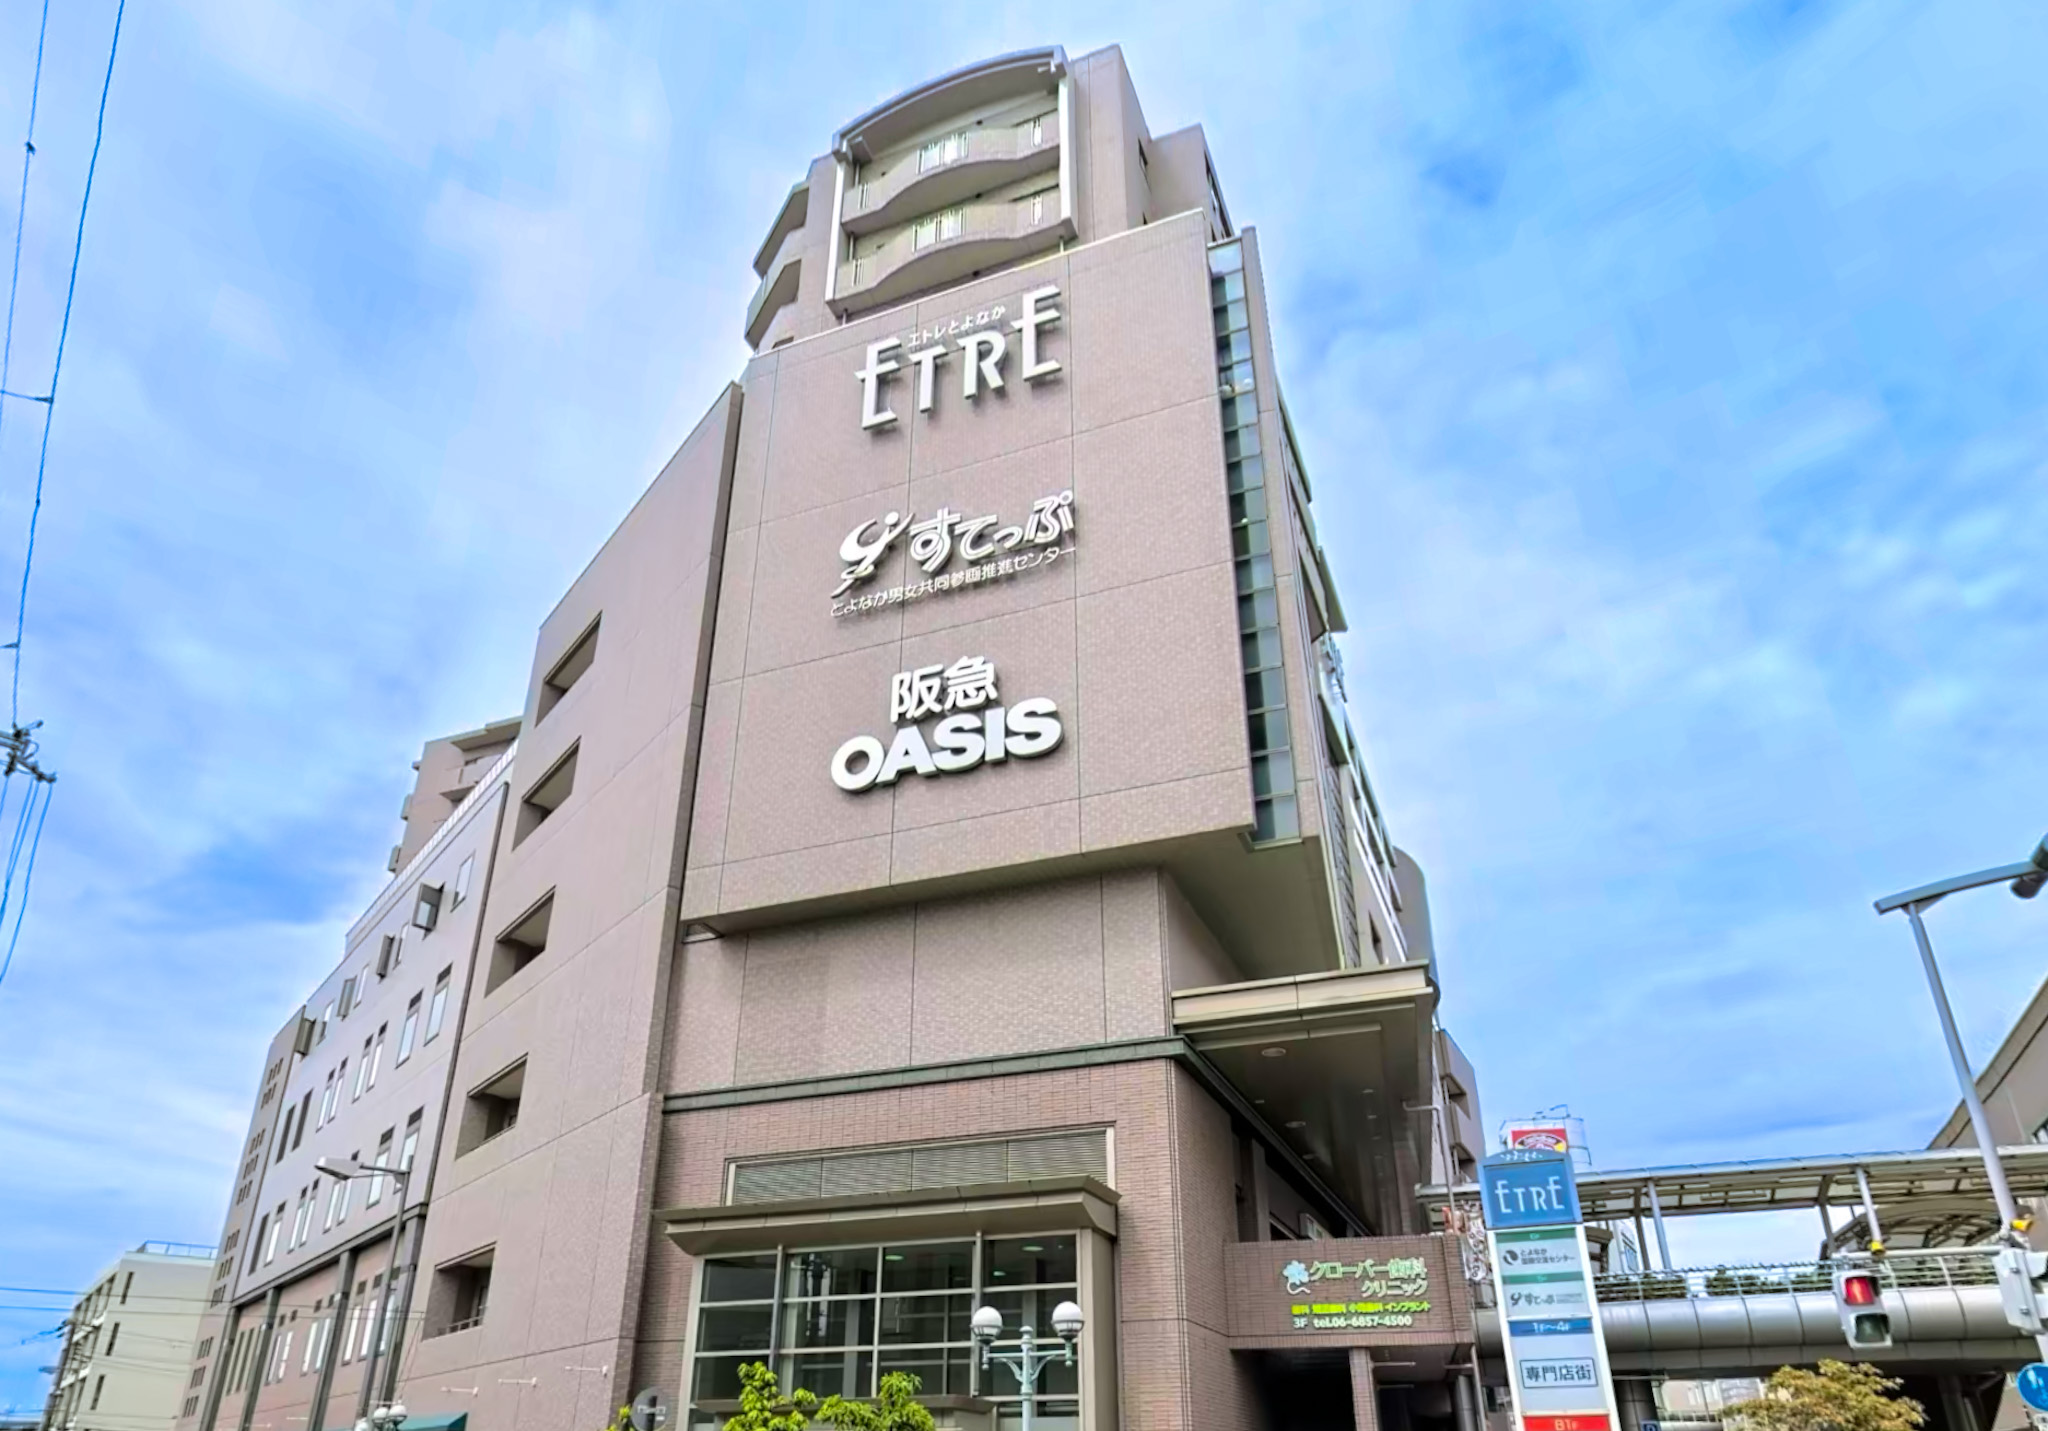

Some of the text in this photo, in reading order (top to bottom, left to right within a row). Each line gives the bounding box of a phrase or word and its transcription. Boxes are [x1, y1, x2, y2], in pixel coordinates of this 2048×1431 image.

[908, 306, 1006, 347] エトレとよなか
[854, 285, 1062, 430] ETRE
[909, 490, 1075, 574] すてっぷ
[830, 546, 1077, 618] とよなか男女共同参画推進センター
[890, 655, 999, 724] 阪急
[831, 697, 1065, 793] OASIS
[1495, 1176, 1566, 1213] ETRE
[1361, 1279, 1428, 1298] クリニック
[1292, 1317, 1309, 1329] 3F
[1525, 1364, 1592, 1382] 専門店街
